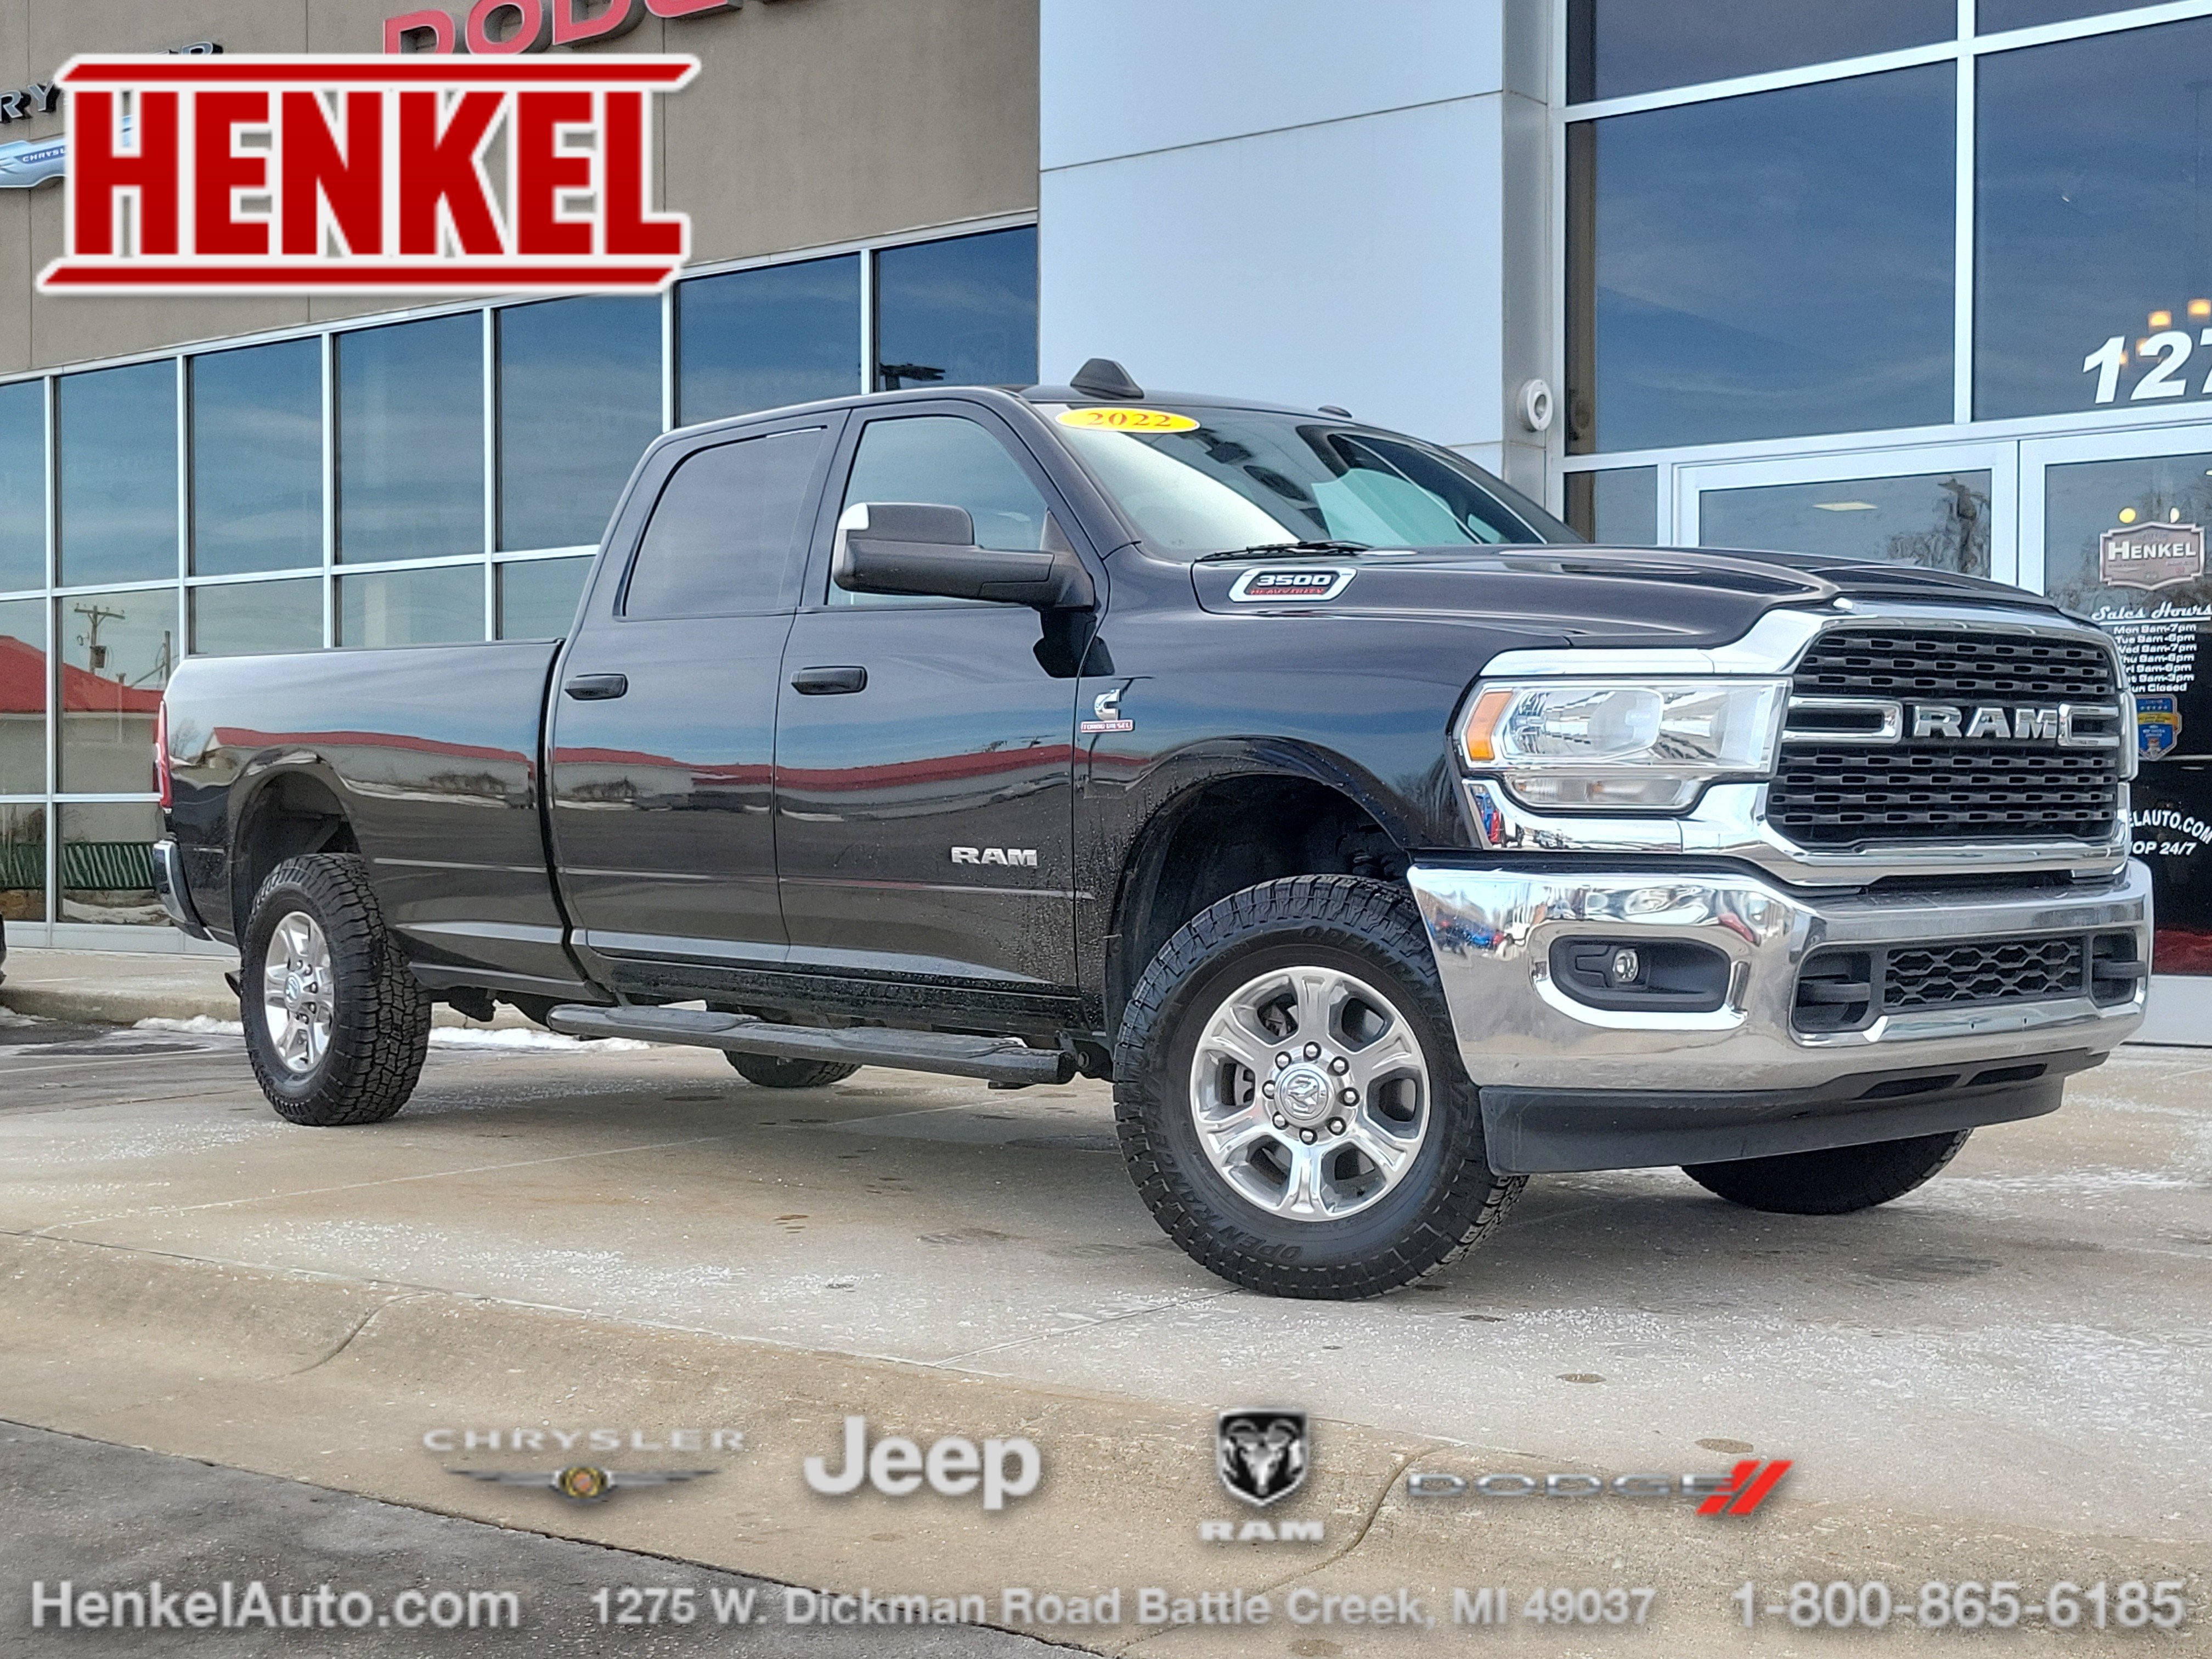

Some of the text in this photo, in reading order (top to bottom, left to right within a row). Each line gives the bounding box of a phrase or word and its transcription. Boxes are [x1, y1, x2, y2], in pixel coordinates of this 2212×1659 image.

[383, 0, 732, 54] DOD
[22, 148, 65, 162] CHRYSL
[1087, 412, 1171, 427] 2022
[2108, 540, 2197, 561] HENKEL
[1256, 574, 1333, 586] 3500
[2091, 601, 2212, 620] Sales Hours
[2113, 626, 2139, 634] Mon
[2115, 635, 2135, 644] Tue
[2122, 655, 2137, 663] hu
[2125, 664, 2134, 673] ri
[2129, 682, 2188, 692] un Closed
[1912, 705, 2058, 738] RAM
[2129, 809, 2212, 844] ELAUTO.COM
[2130, 840, 2197, 855] OP 24/7
[951, 846, 1038, 866] RAM
